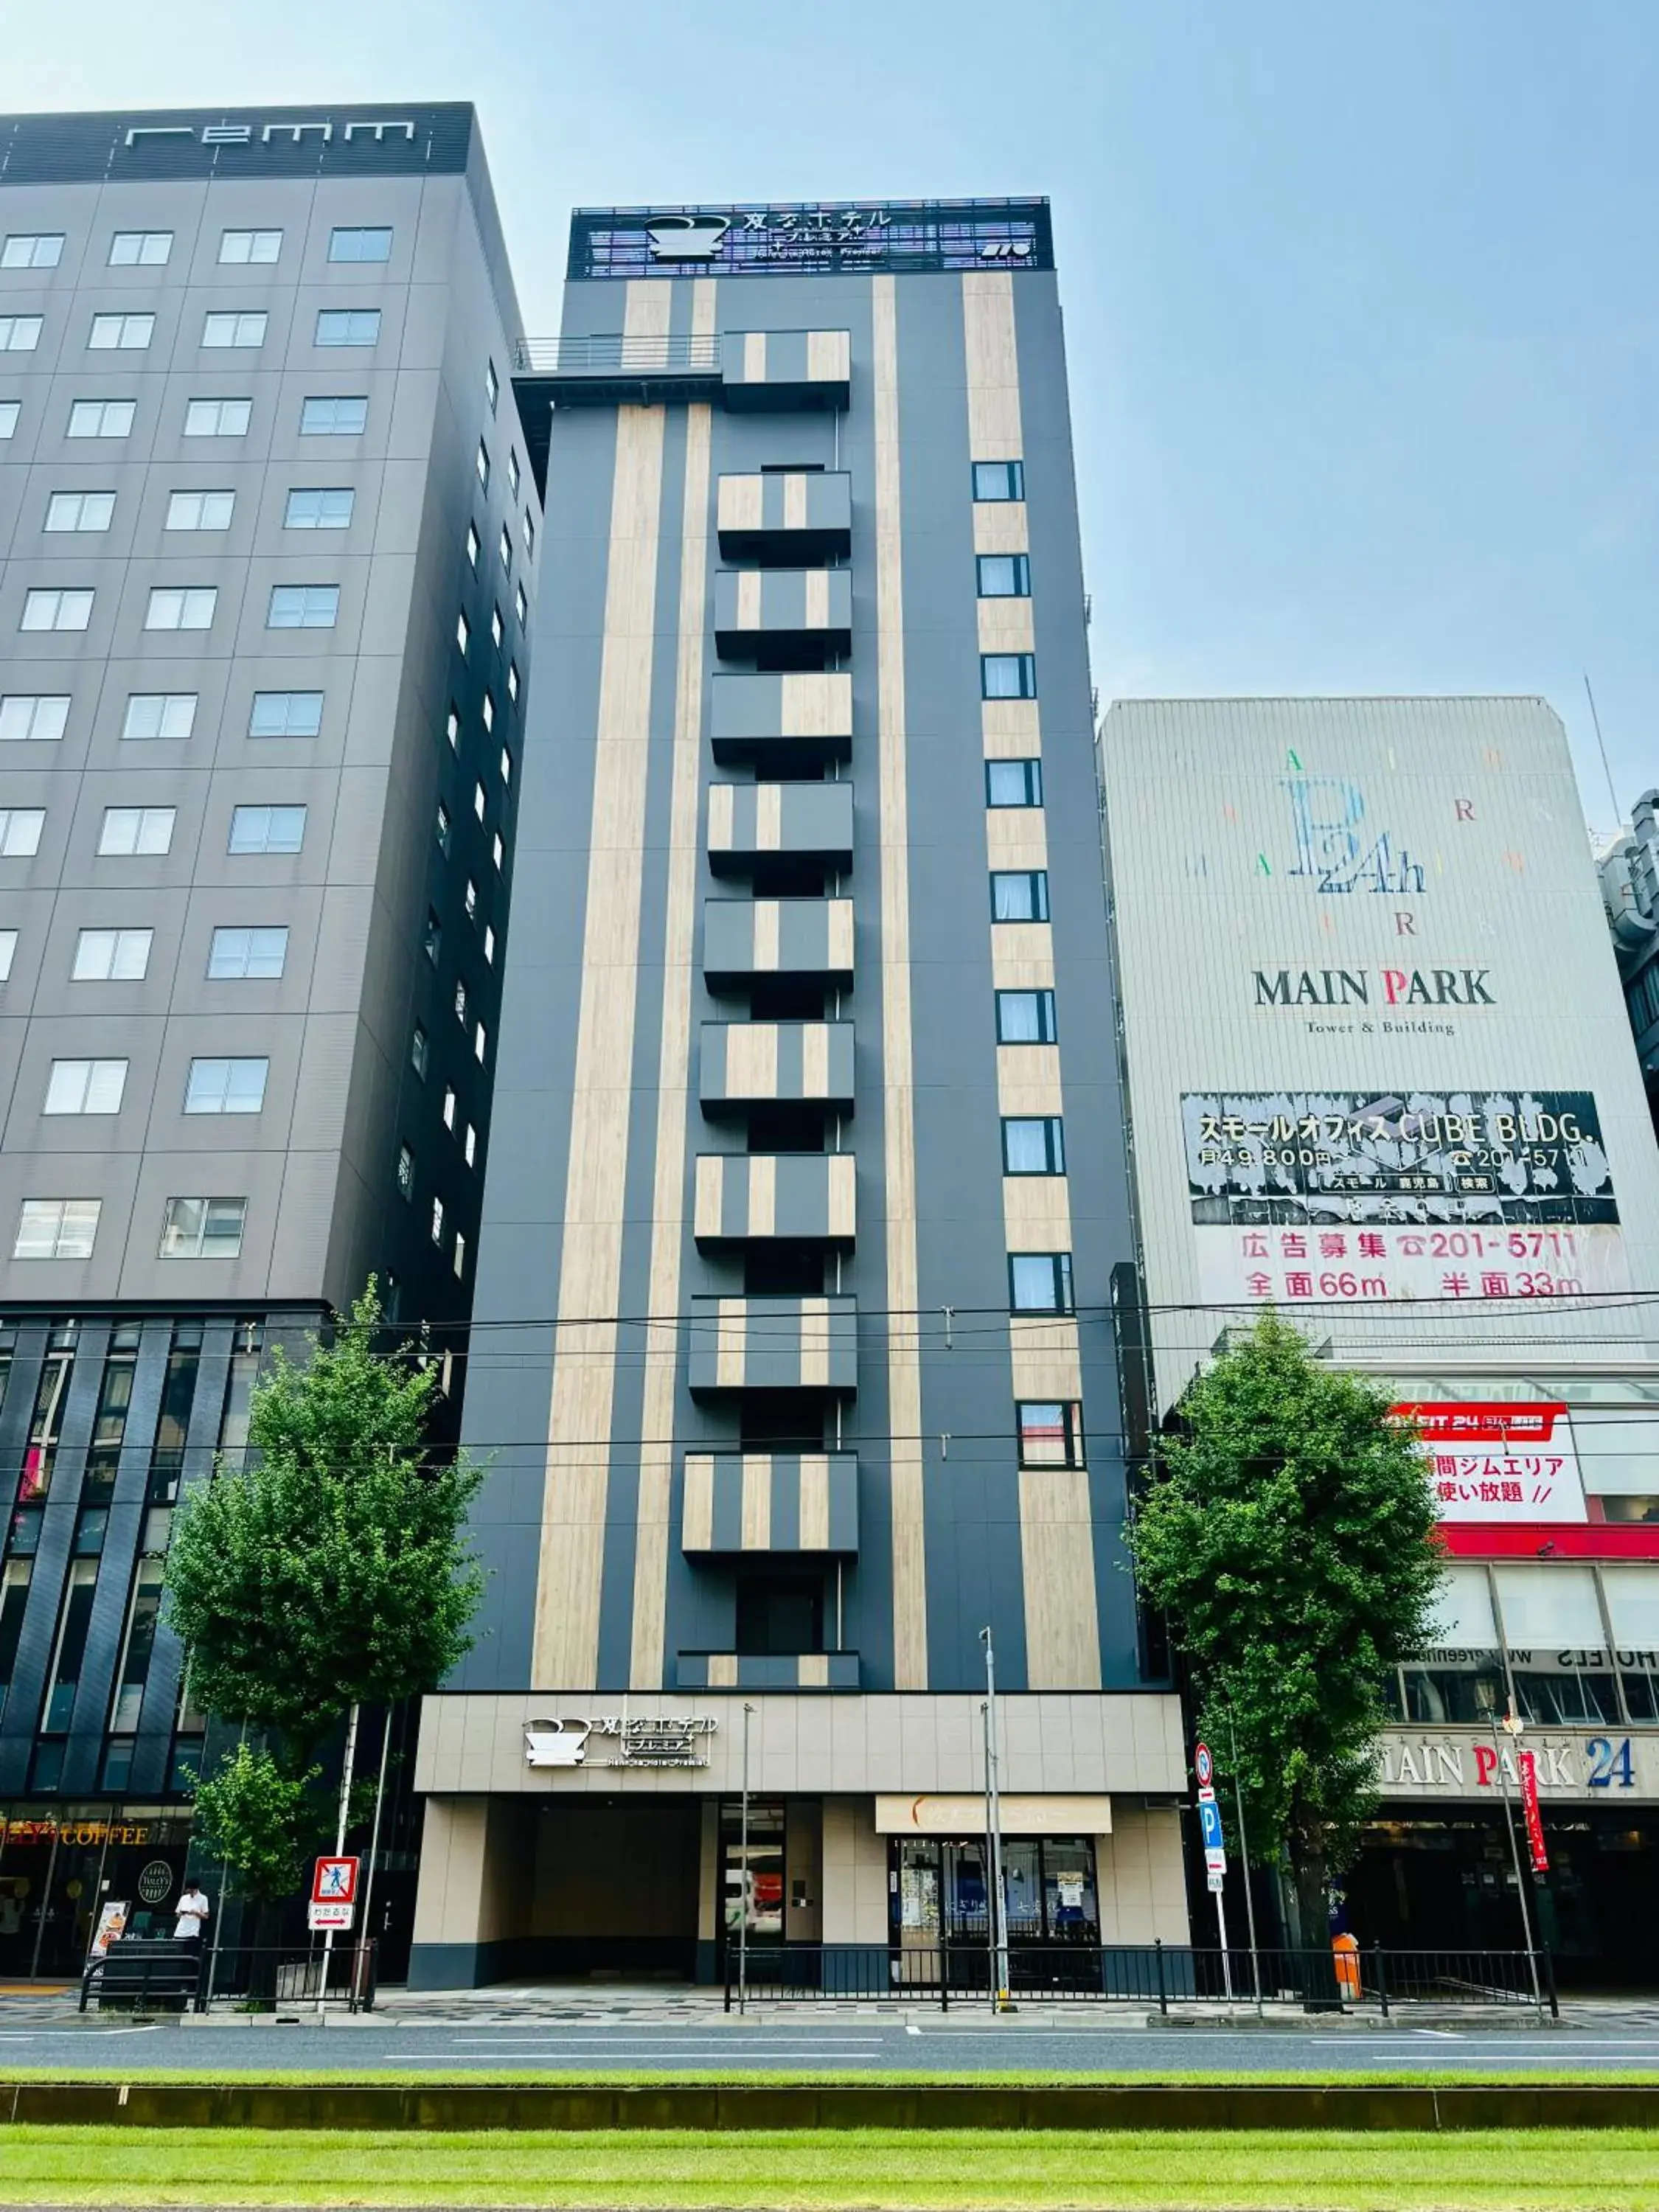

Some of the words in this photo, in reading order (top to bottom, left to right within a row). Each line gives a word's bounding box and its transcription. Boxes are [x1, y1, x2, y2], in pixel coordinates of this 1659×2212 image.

[124, 121, 414, 147] remm
[1454, 798, 1477, 822] R
[1393, 911, 1418, 936] R
[1251, 968, 1370, 1006] MAIN
[1380, 967, 1498, 1006] PARK
[1306, 1020, 1354, 1034] Tower
[1382, 1020, 1455, 1037] Building
[1399, 1113, 1486, 1144] CUBE
[1497, 1113, 1594, 1143] BLDG.
[1242, 1232, 1387, 1259] 広告募集
[1587, 1737, 1635, 1788] 24
[62, 1827, 149, 1845] COFFEE
[1204, 1807, 1215, 1844] P
